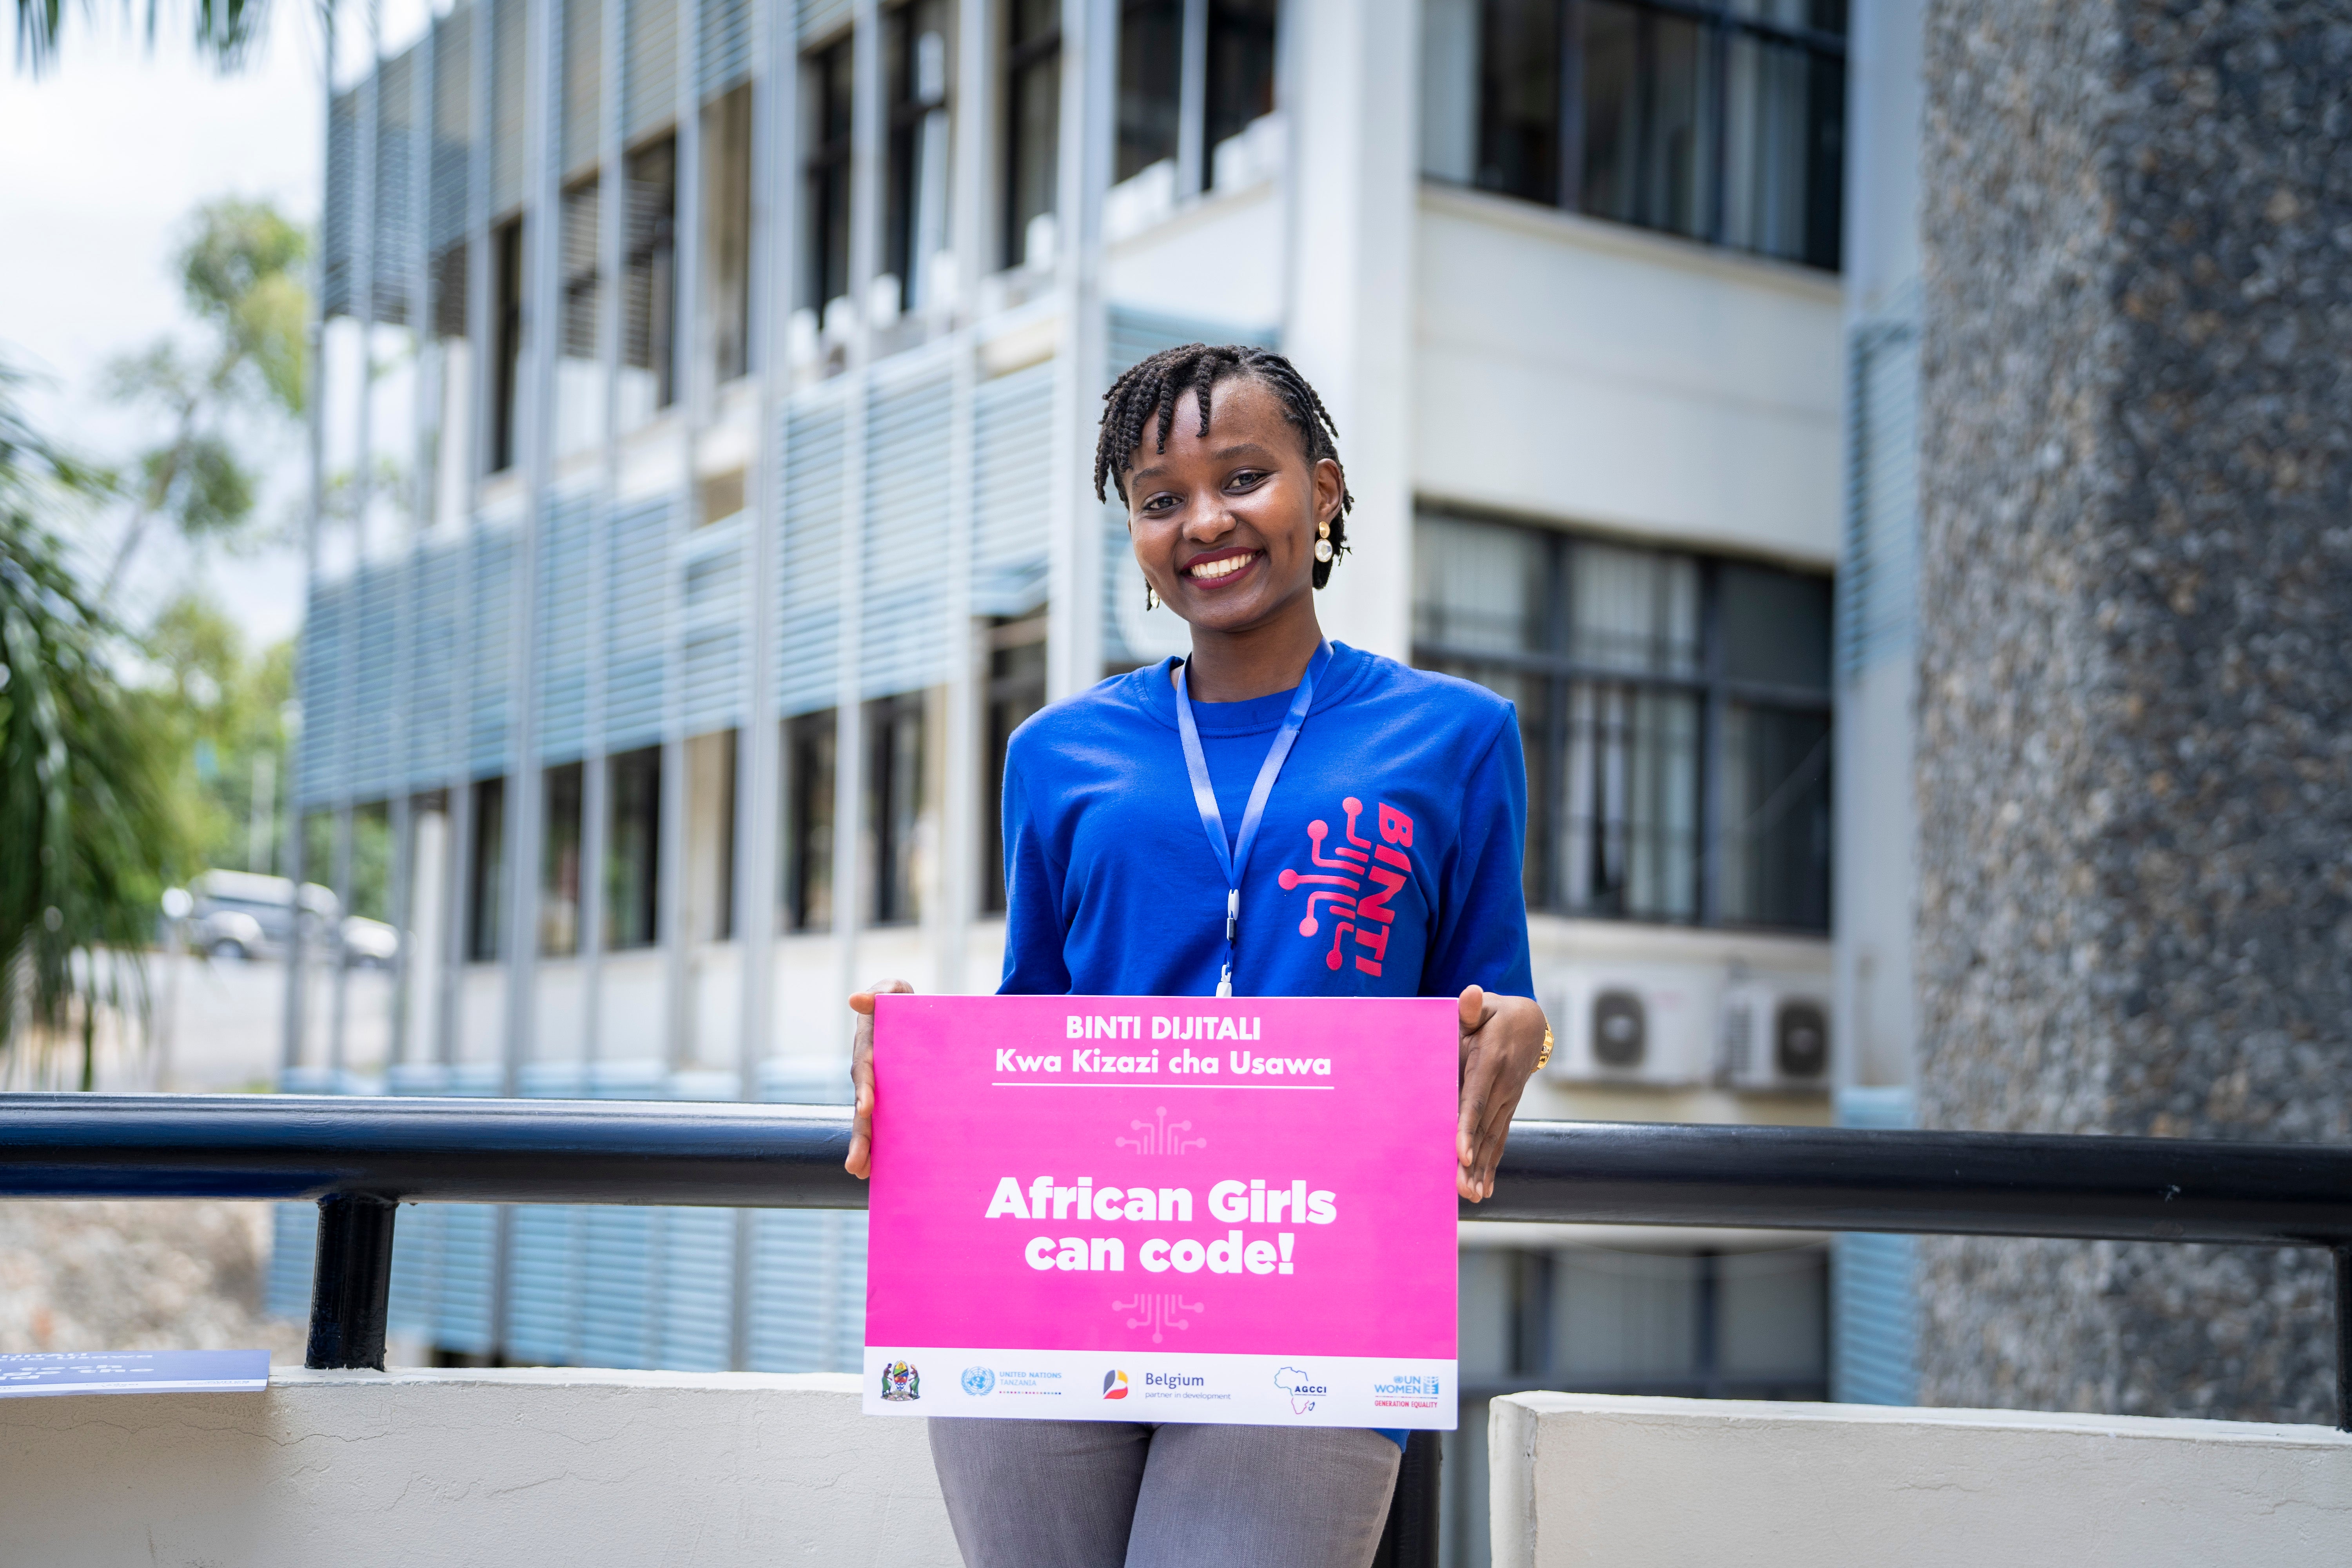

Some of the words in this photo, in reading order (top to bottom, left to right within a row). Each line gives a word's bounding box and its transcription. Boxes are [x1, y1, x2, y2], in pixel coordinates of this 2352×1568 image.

[1356, 802, 1413, 977] BINTI
[1066, 1016, 1141, 1039] BINTI
[1151, 1016, 1261, 1040] DIJITALI
[996, 1049, 1062, 1073] Kwa
[1072, 1048, 1159, 1073] Kizazi
[1169, 1049, 1219, 1074] cha
[1230, 1051, 1331, 1076] Usawa
[985, 1176, 1193, 1221] African
[1208, 1179, 1337, 1225] Girls
[1025, 1236, 1125, 1271] can
[1139, 1230, 1295, 1275] code!
[1146, 1373, 1204, 1389] Belgium
[1374, 1384, 1421, 1394] WOMEN
[1405, 1376, 1421, 1384] UN
